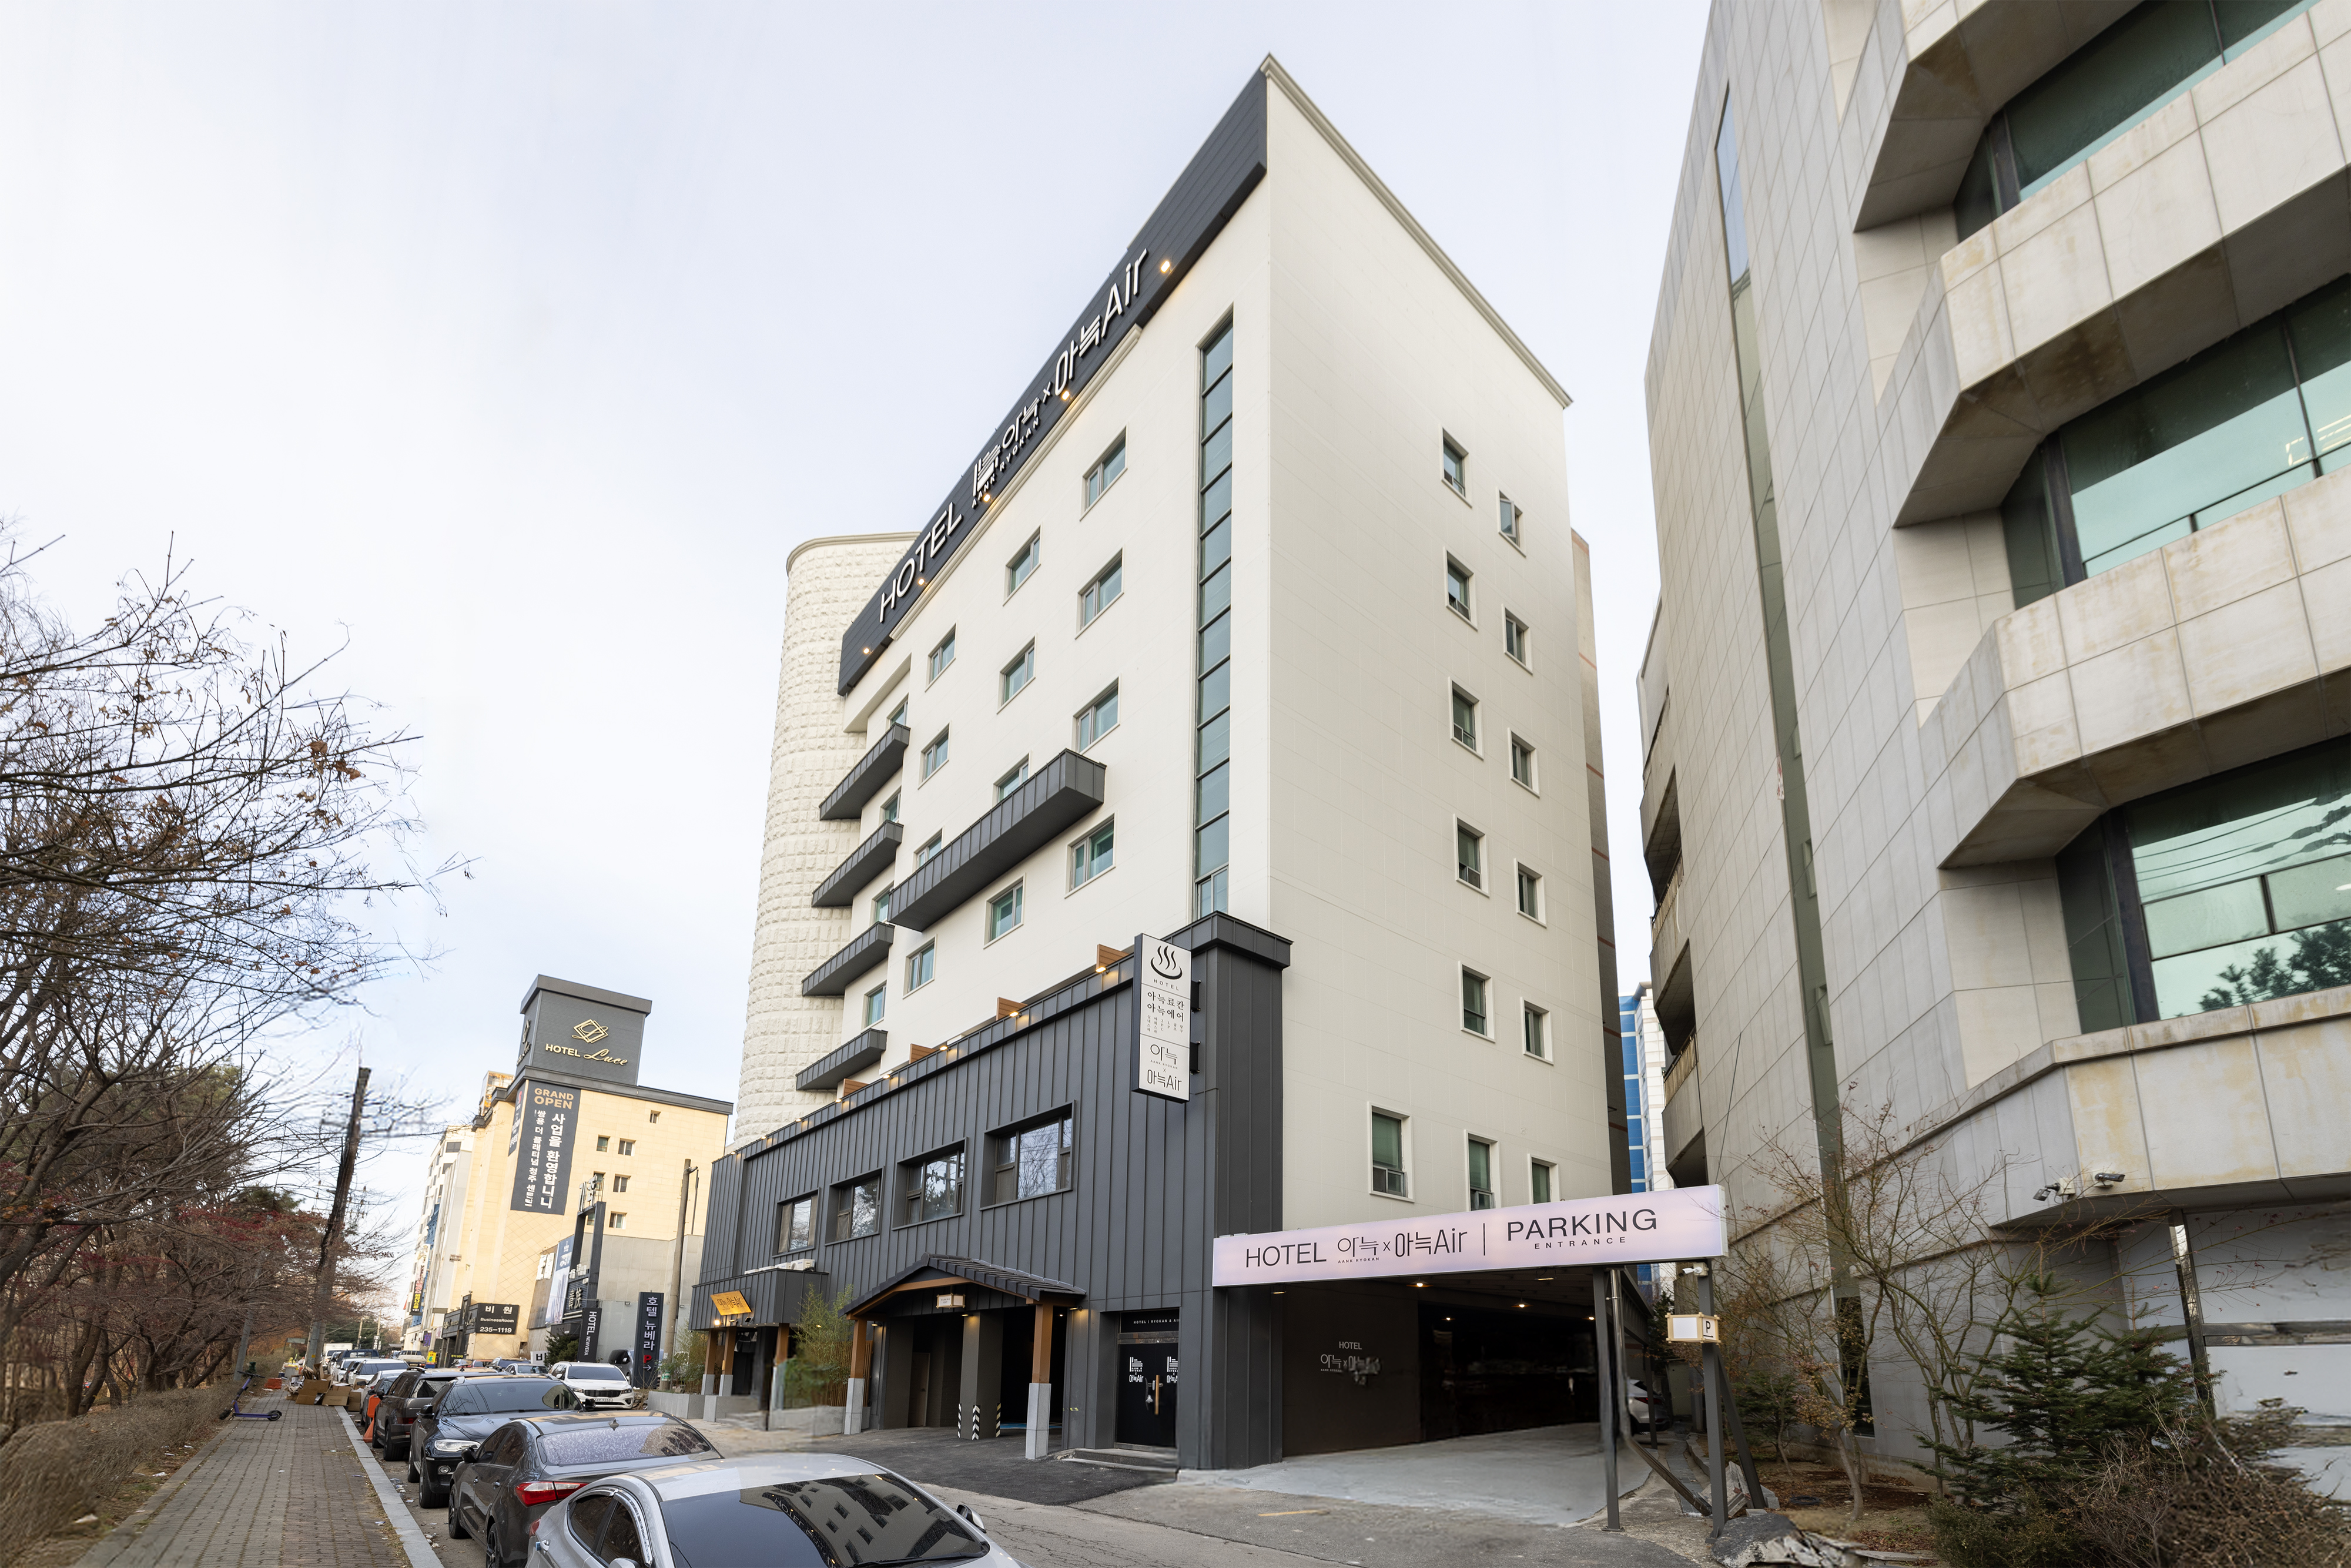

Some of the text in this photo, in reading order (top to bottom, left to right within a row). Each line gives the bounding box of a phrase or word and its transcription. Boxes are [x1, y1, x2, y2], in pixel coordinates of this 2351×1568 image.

[972, 416, 1039, 509] AANK RYOKAN
[879, 501, 963, 623] HOTEL
[1154, 979, 1179, 991] HOTEL
[1147, 991, 1184, 1011] 아늑료칸
[1147, 1003, 1184, 1022] 아늑에어
[545, 1043, 581, 1057] HOTEL
[584, 1048, 628, 1066] Luce
[1147, 1069, 1182, 1091] 아늑Air
[534, 1088, 574, 1101] GRAND
[534, 1095, 572, 1110] OPEN
[535, 1127, 544, 1135] 더
[548, 1113, 566, 1148] 사업을
[528, 1167, 538, 1183] 청주
[1246, 1242, 1327, 1268] HOTEL
[1395, 1228, 1468, 1257] 아늑Air
[1507, 1209, 1657, 1241] PARKING
[1535, 1237, 1626, 1249] ENTRANCE
[485, 1305, 513, 1314] 비 원
[647, 1296, 658, 1317] 호텔
[587, 1311, 597, 1335] HOTEL
[1706, 1320, 1711, 1334] P
[643, 1321, 657, 1351] 뉴베라
[1339, 1341, 1362, 1350] HOTEL
[644, 1354, 652, 1363] P
